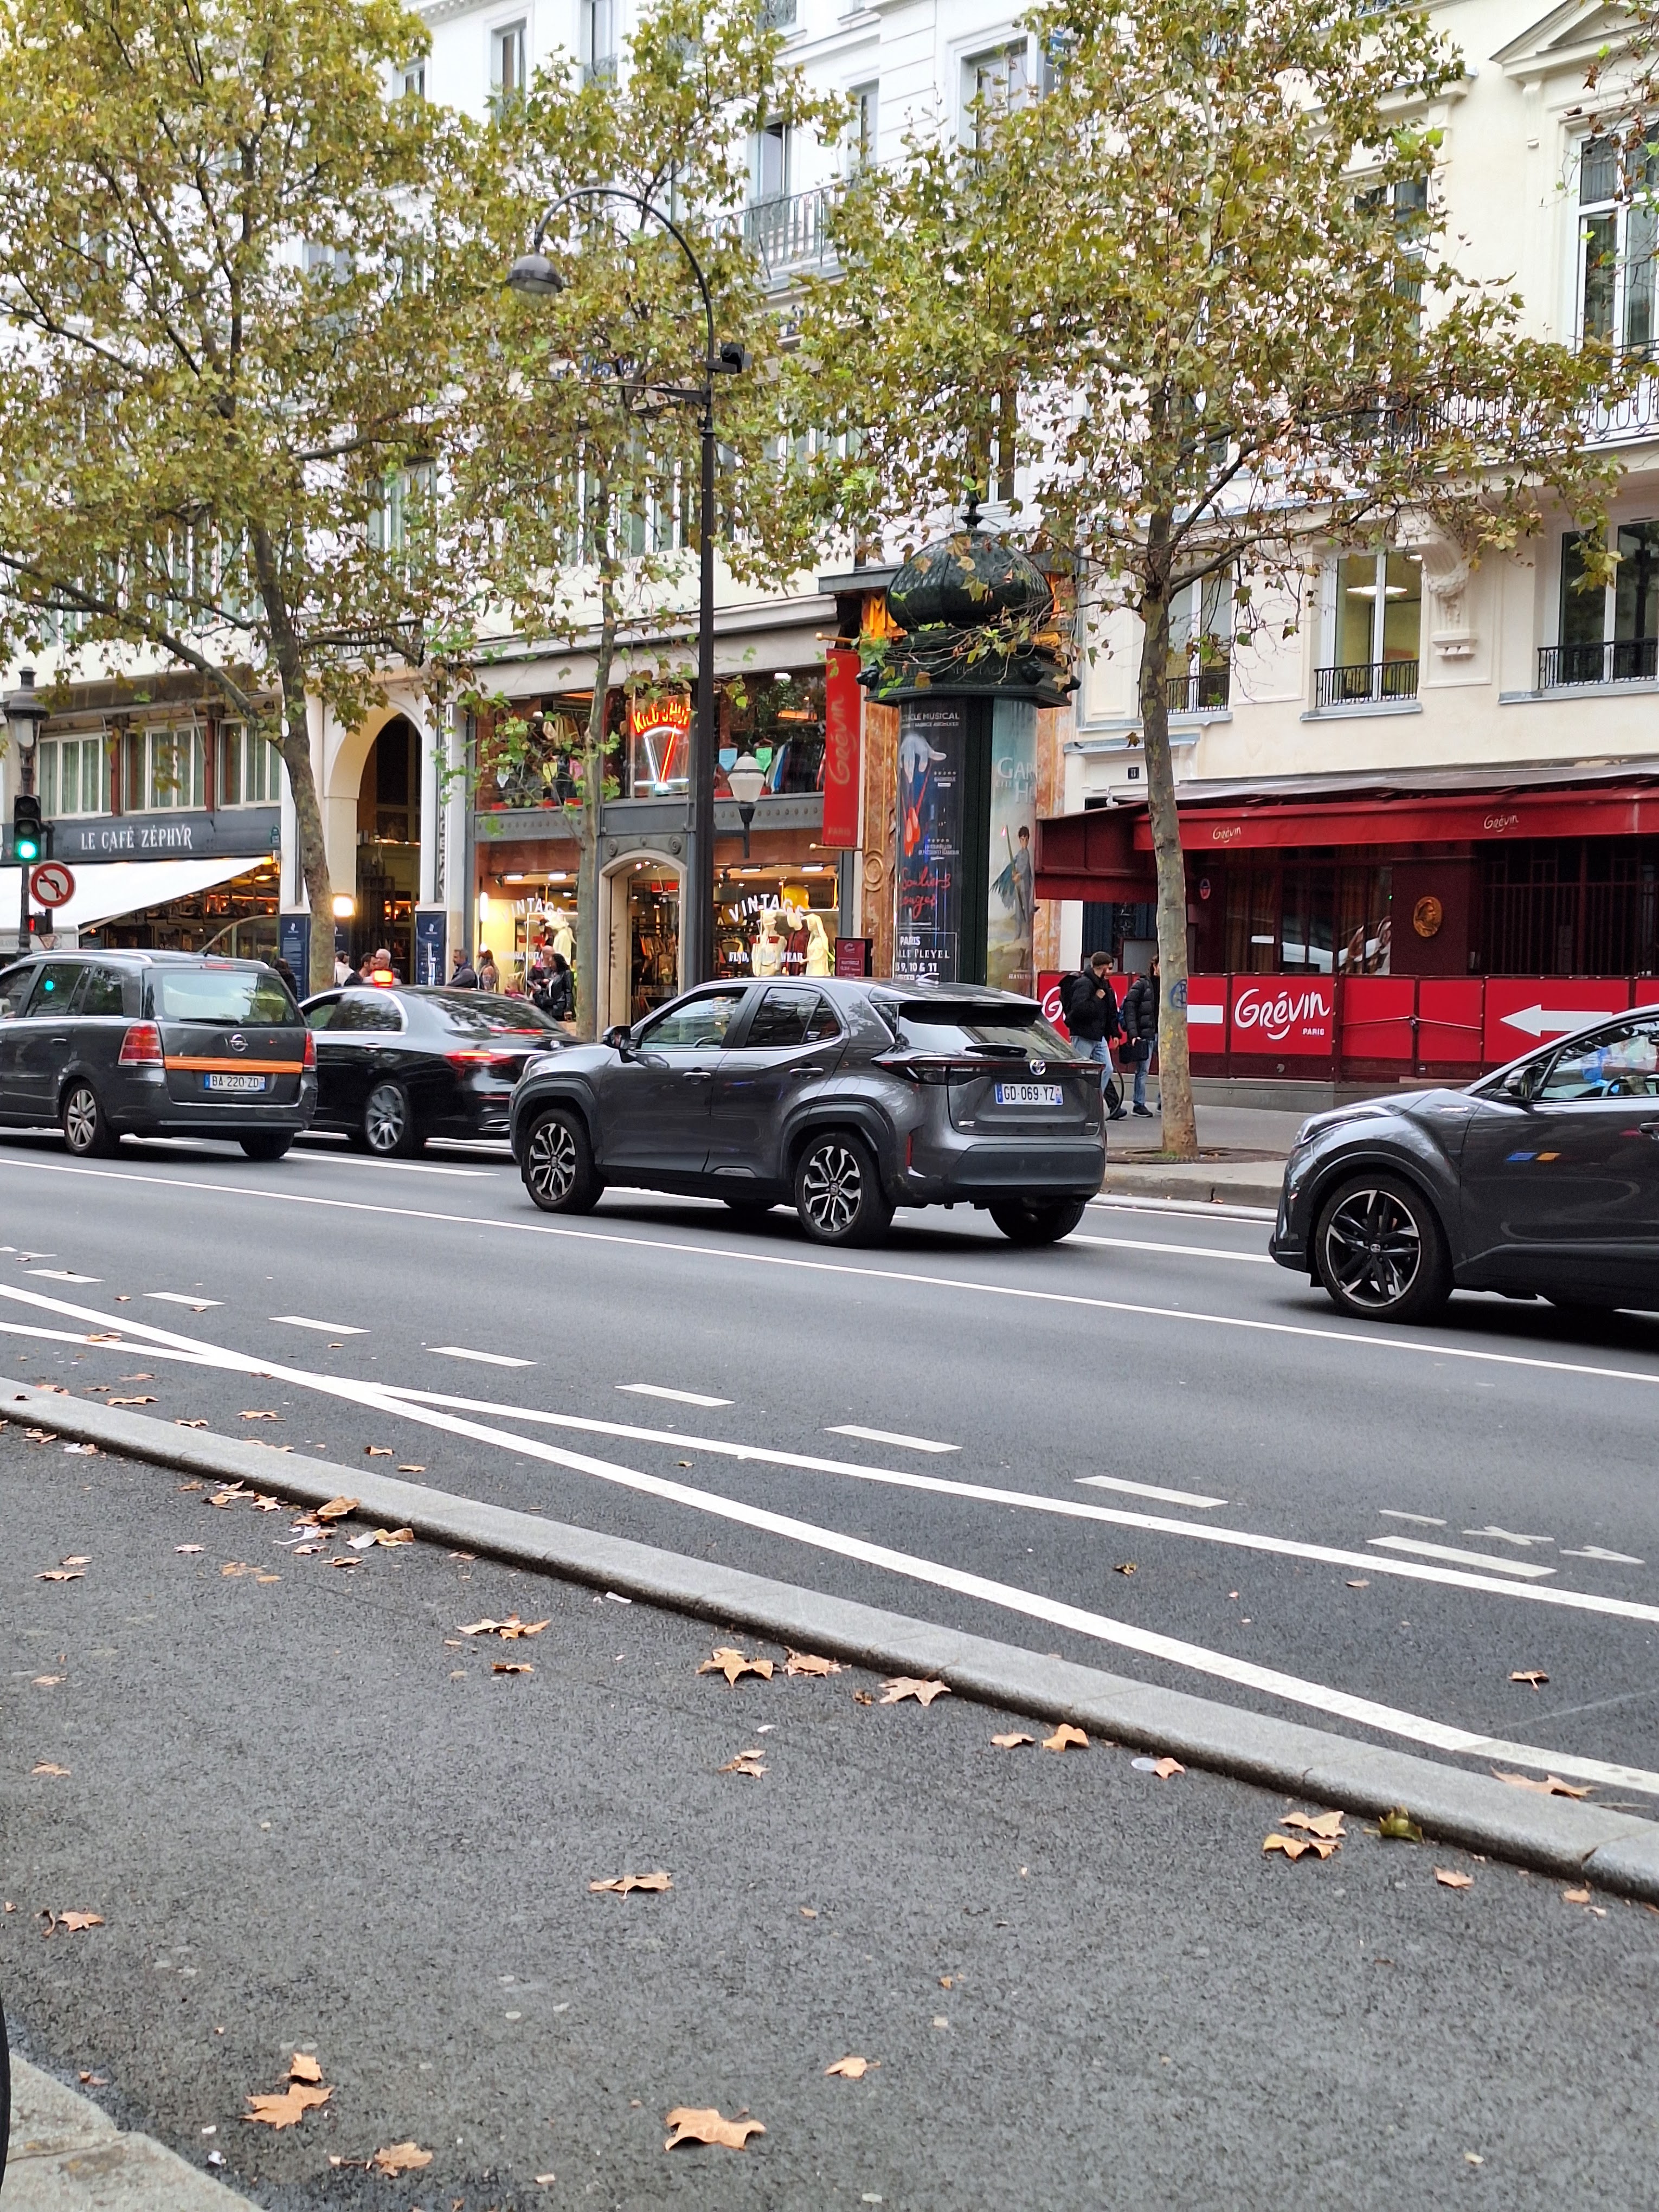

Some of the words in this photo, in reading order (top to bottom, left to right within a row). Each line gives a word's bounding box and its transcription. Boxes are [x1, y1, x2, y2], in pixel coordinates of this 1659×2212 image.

[923, 712, 960, 720] MUSICAL
[81, 832, 95, 850] LE
[101, 826, 134, 853] CAFÉ
[141, 824, 192, 850] ZÉPHYR
[900, 936, 921, 946] PARIS
[915, 948, 950, 959] PLEYEL
[909, 962, 917, 972] 10
[928, 962, 937, 972] 11
[1302, 1027, 1324, 1036] PARIS
